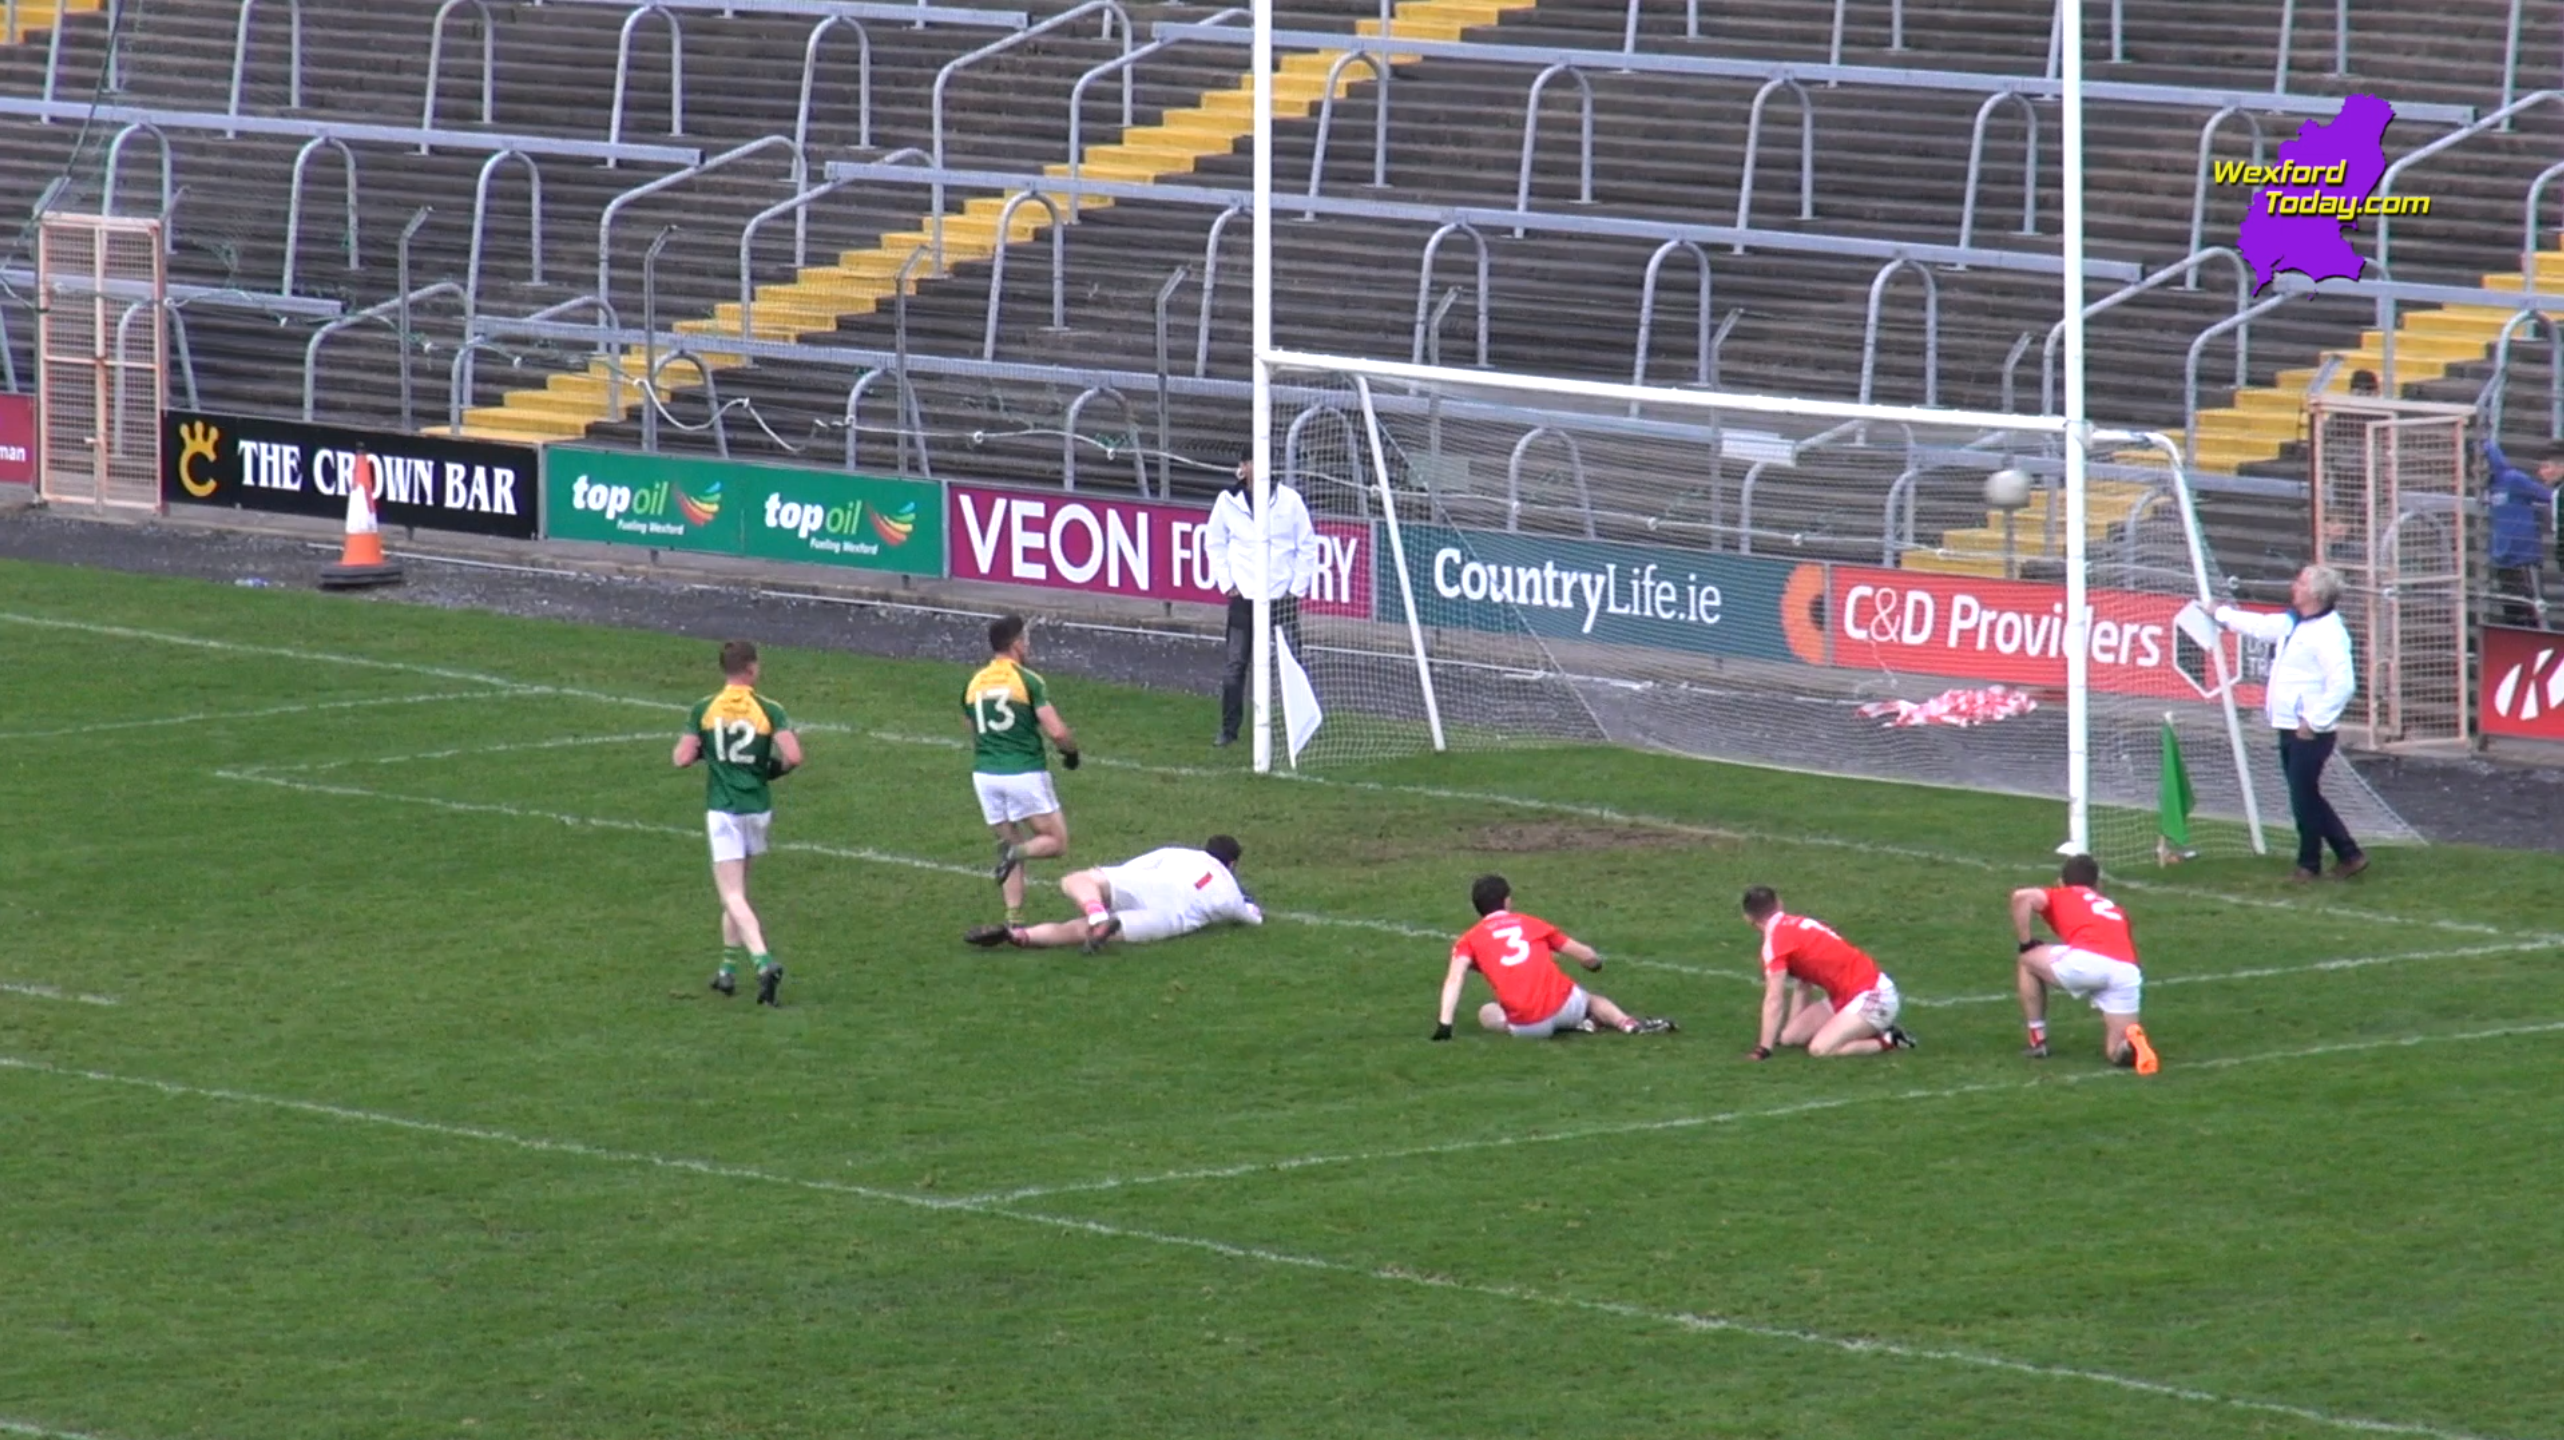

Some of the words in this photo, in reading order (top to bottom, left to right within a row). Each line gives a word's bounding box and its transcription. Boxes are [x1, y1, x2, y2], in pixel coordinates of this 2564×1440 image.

[237, 439, 303, 492] THE
[444, 461, 518, 515] BAR
[958, 493, 1150, 592] VEON
[1433, 547, 1722, 634] CountryLife.ie
[1843, 584, 1936, 646] C&D
[976, 687, 1016, 734] 13
[713, 716, 757, 765] 12
[2082, 892, 2123, 921] 2
[1492, 925, 1530, 967] 3
